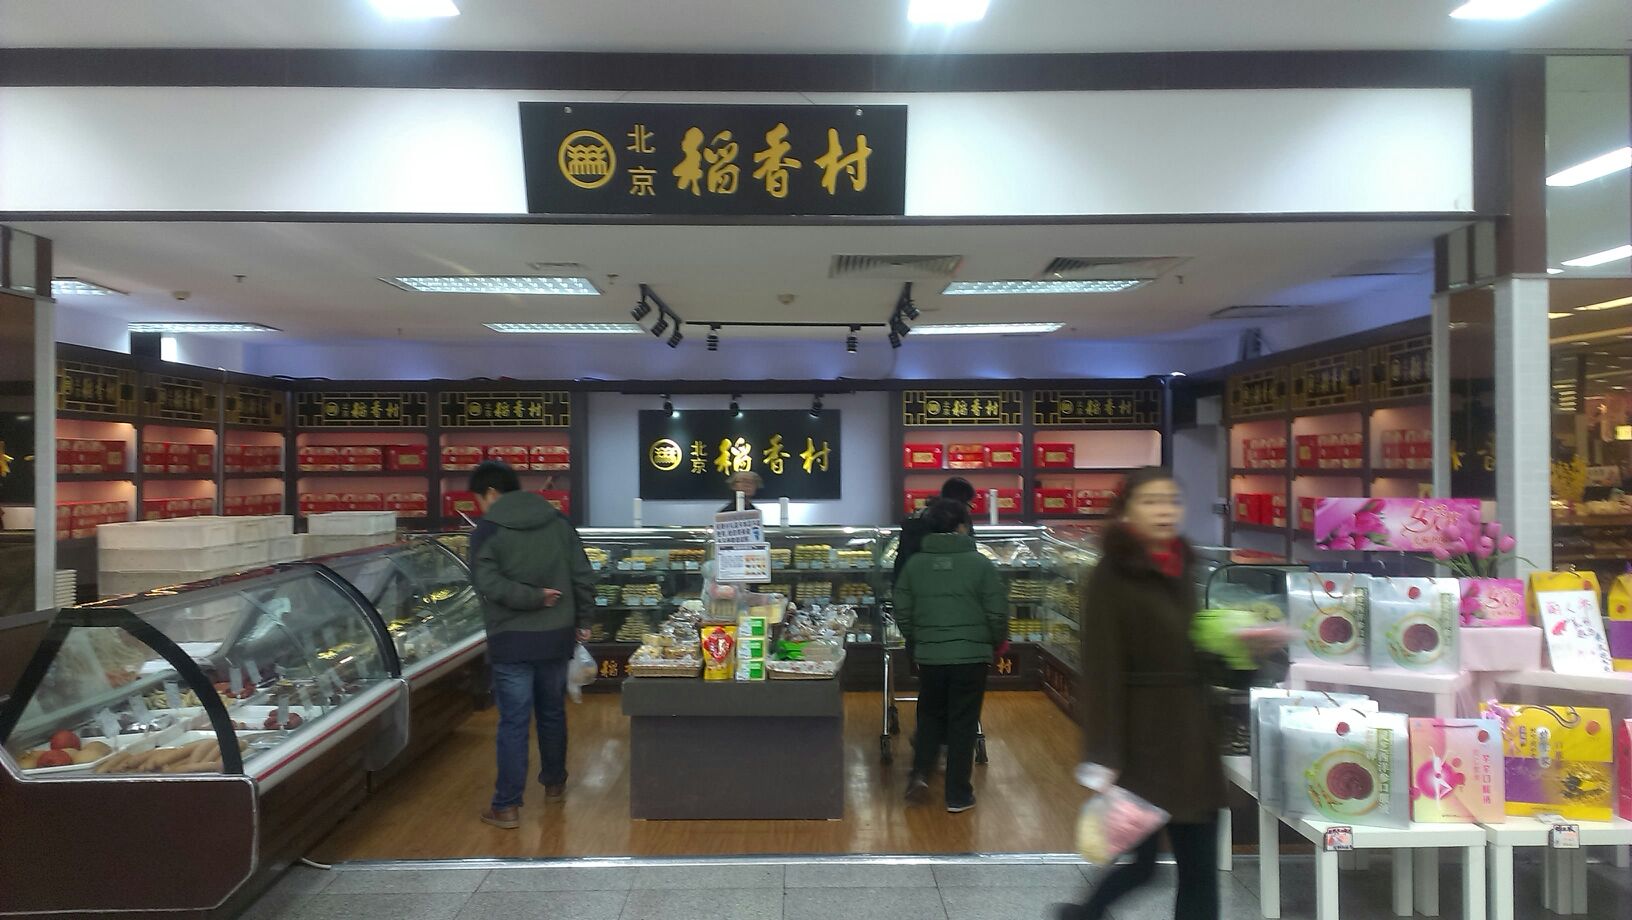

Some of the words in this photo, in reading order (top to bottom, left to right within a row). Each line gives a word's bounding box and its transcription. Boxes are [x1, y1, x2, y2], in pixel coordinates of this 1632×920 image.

[672, 122, 873, 199] 稻香村
[715, 434, 831, 476] 稻香村
